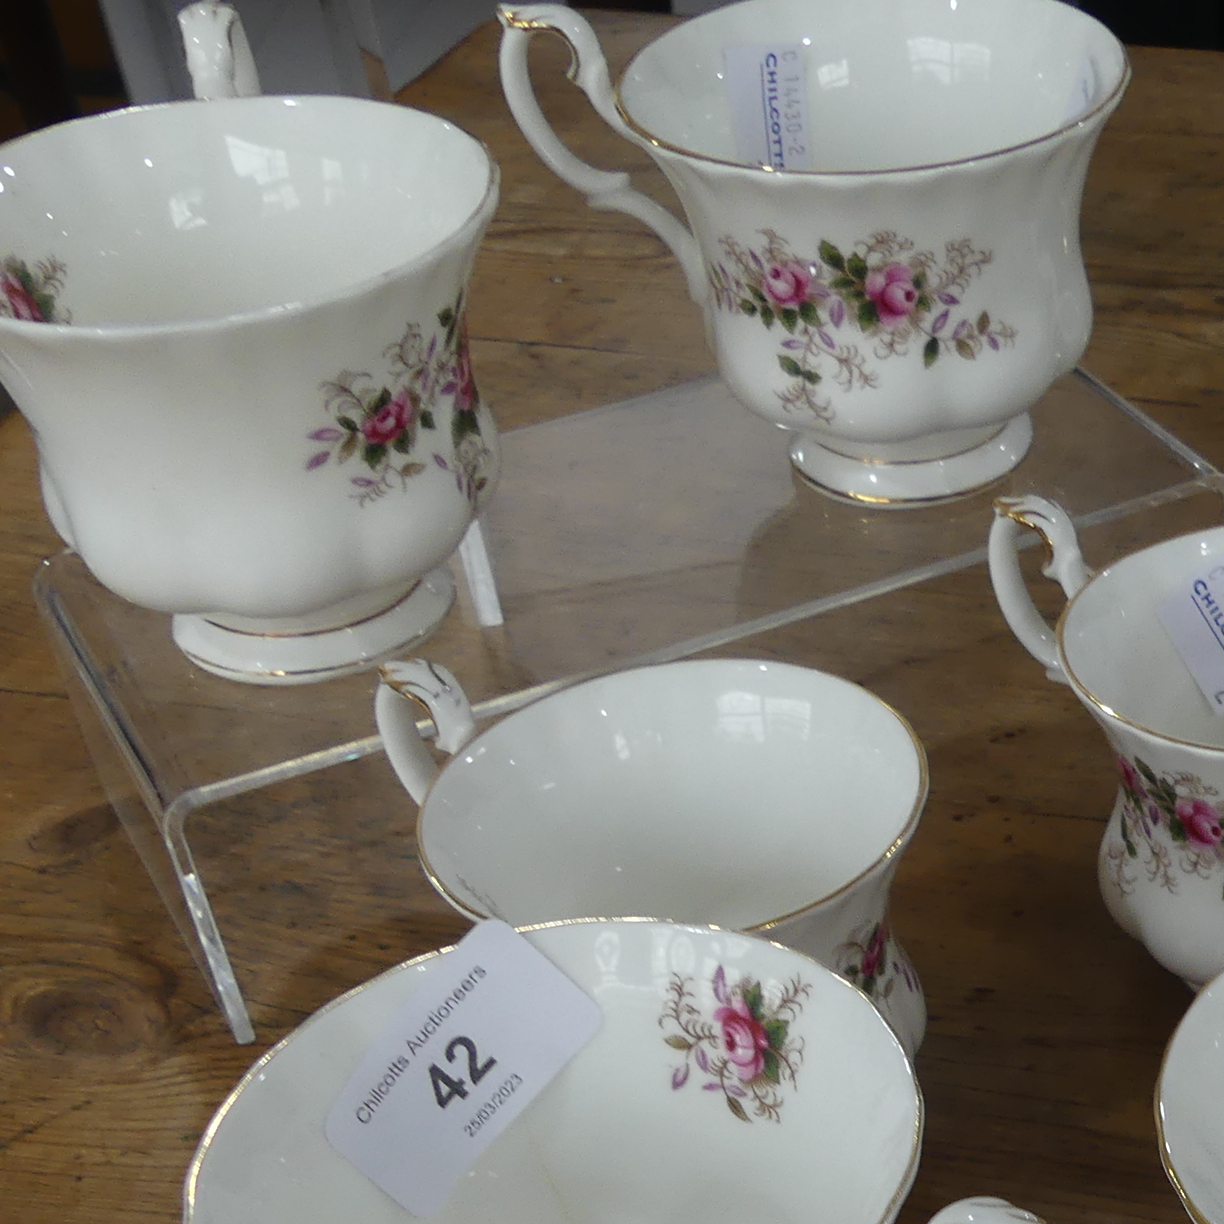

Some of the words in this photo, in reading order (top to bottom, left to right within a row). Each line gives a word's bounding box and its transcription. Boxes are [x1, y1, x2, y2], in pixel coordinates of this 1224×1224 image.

[356, 1057, 410, 1125] Chilcotts
[405, 964, 488, 1057] Auctioneers
[427, 1035, 498, 1110] 42
[463, 1072, 524, 1138] 25/03/2023
